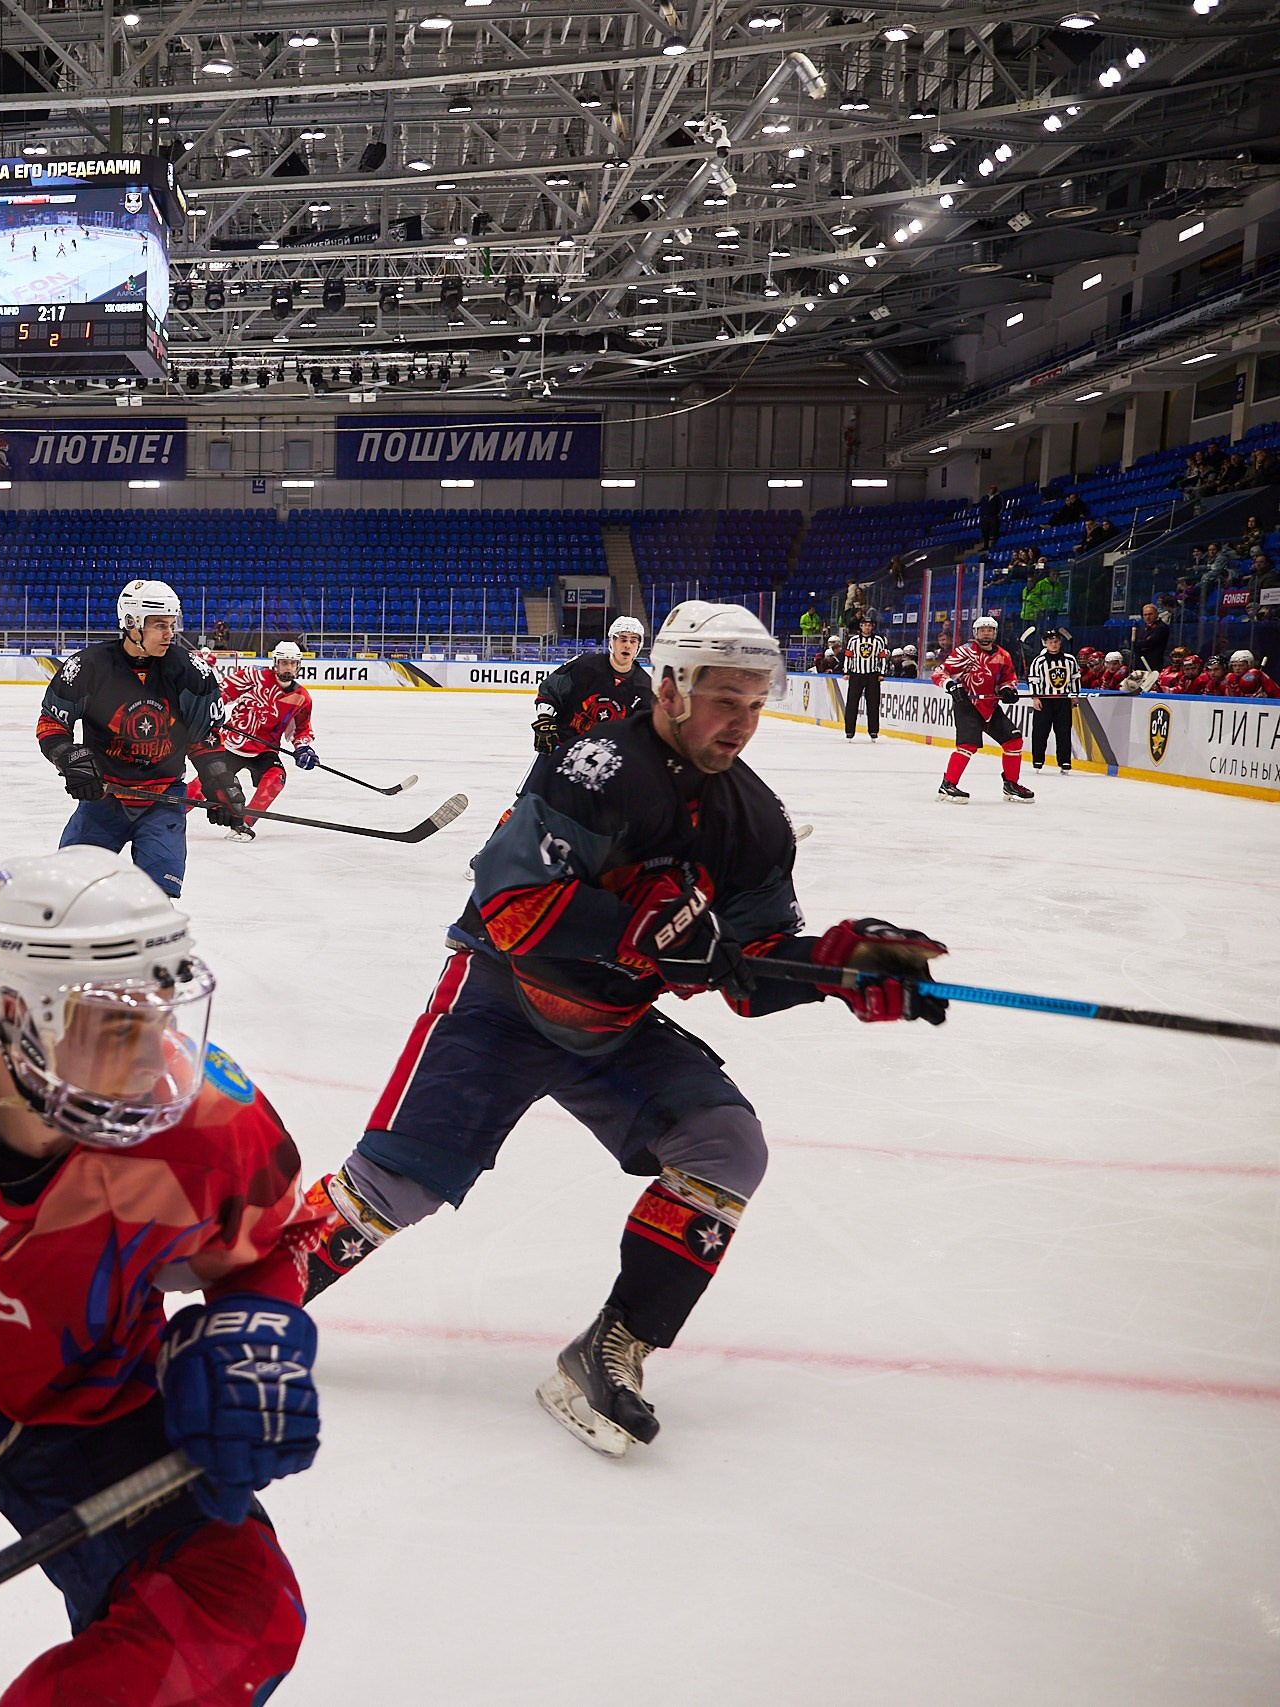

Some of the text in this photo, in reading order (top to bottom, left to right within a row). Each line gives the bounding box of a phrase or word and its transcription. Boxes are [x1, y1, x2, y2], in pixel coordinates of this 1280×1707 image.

[14, 163, 42, 179] ЕГО
[47, 159, 142, 178] ПРЕДЕЛАМИ
[38, 306, 67, 321] 2:17
[19, 323, 29, 340] 5
[85, 322, 91, 339] 1
[49, 333, 59, 347] 2
[1237, 376, 1245, 392] 2
[28, 434, 174, 465] ЛЮТЫЕ!
[357, 431, 574, 462] ПОШУМИМ!
[1223, 592, 1250, 605] FONBET
[324, 667, 368, 681] ЛИГА
[470, 669, 550, 684] OHLIGA.R
[1151, 710, 1168, 737] ОХЛ
[654, 885, 708, 951] BAU
[145, 929, 186, 948] BAUER
[169, 1310, 290, 1360] UER
